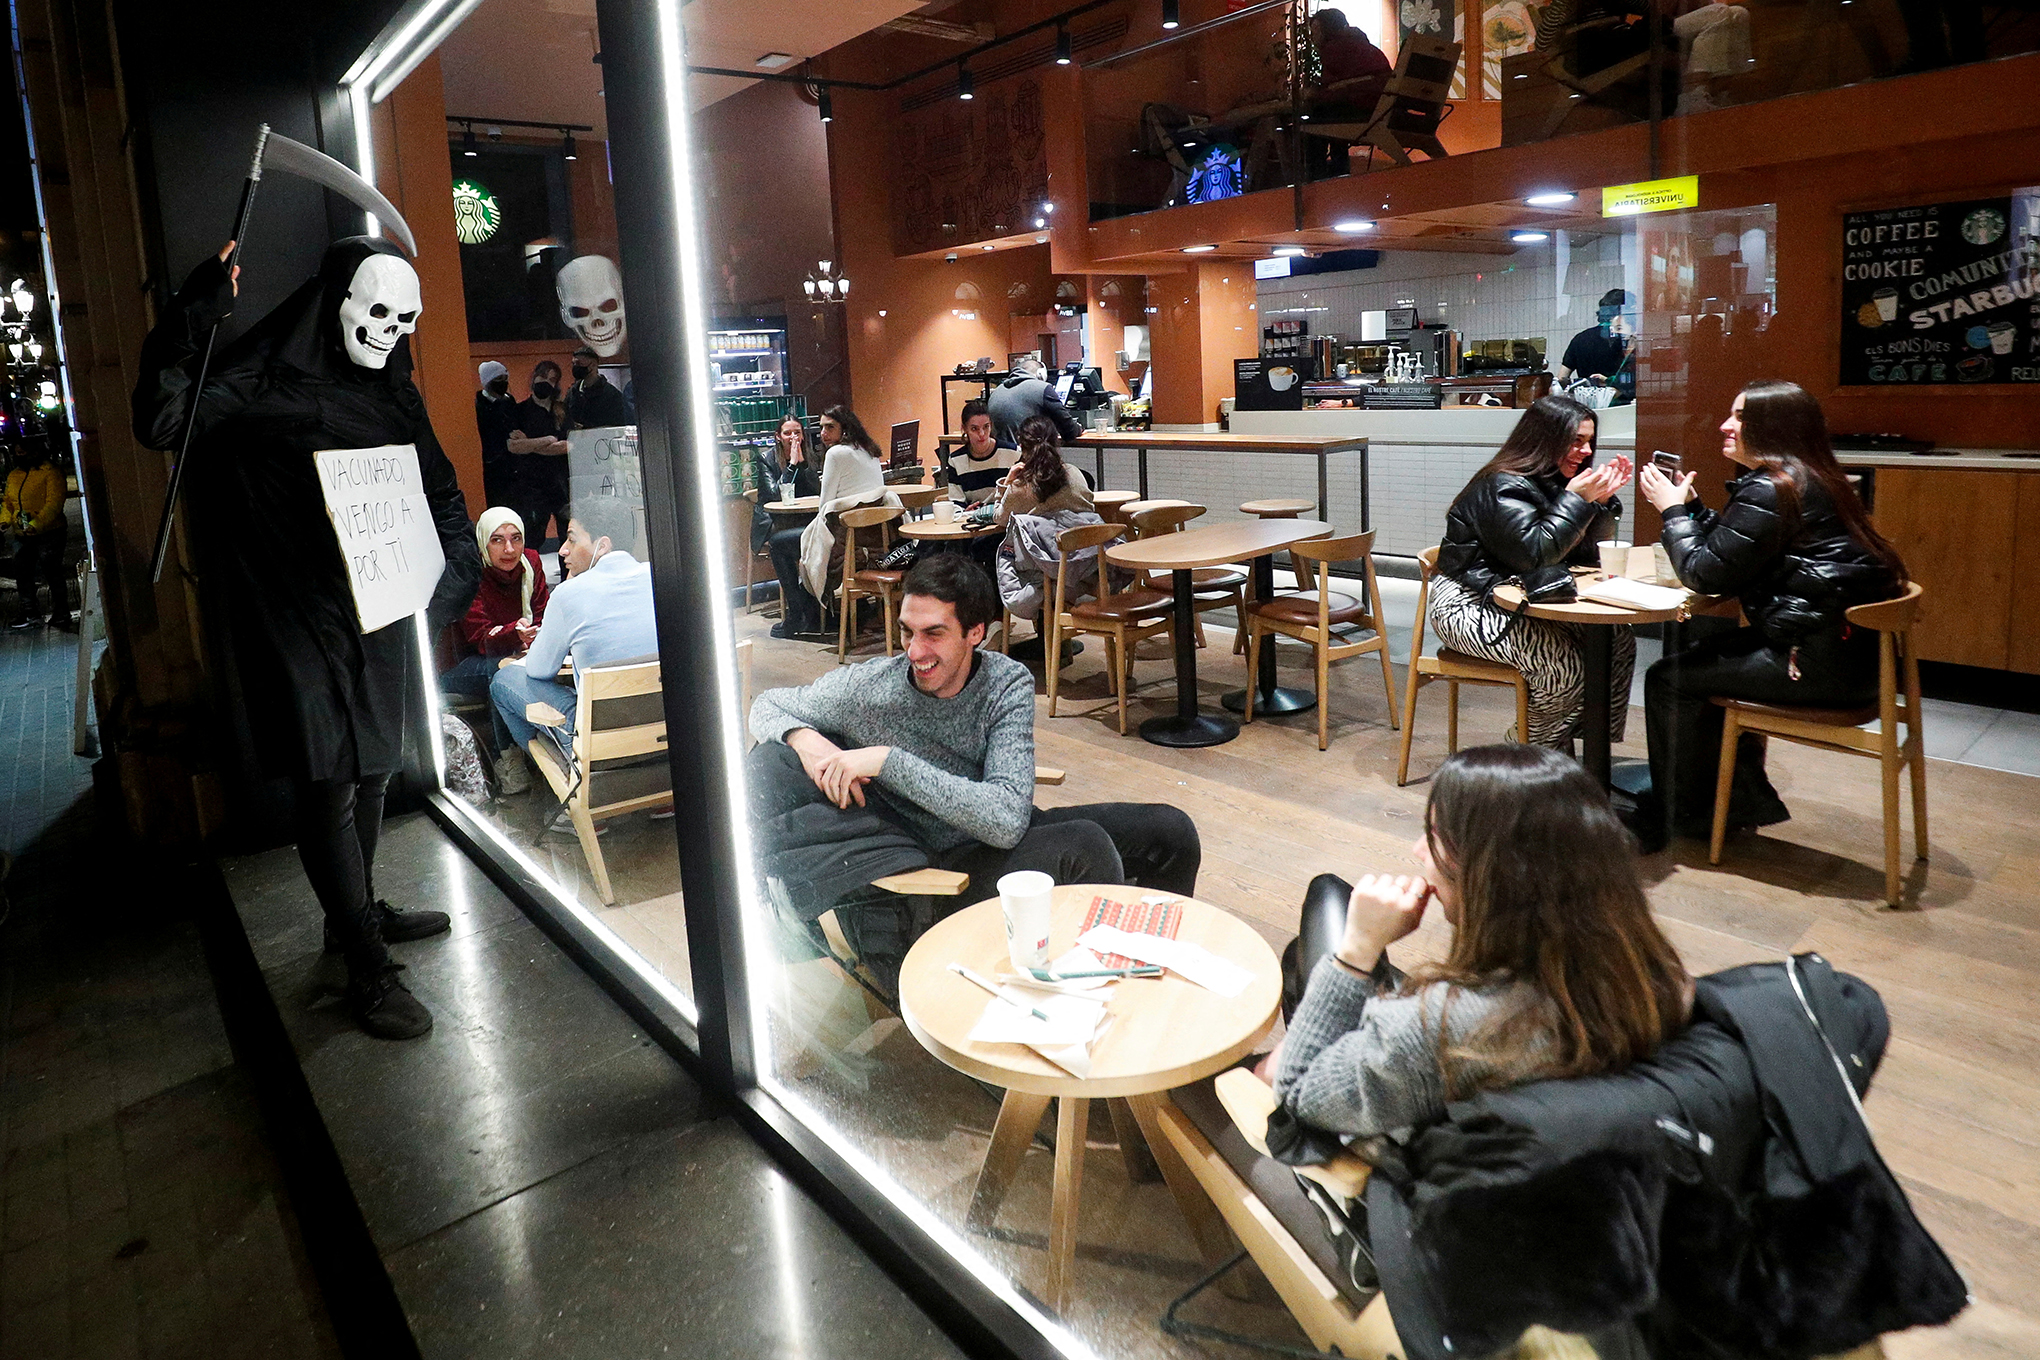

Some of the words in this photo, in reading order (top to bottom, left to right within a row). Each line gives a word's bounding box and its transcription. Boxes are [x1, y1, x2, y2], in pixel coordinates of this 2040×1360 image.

[1898, 209, 1923, 218] NEED
[1846, 220, 1940, 246] COFFEE
[1849, 250, 1873, 259] AND
[1882, 245, 1919, 255] MAYBE
[1844, 258, 1925, 280] COOKIE
[1888, 337, 1921, 354] BONS
[1924, 338, 1951, 353] DIES
[322, 457, 406, 491] VACUNADO,
[335, 500, 395, 540] VENGO
[402, 497, 415, 525] A
[353, 549, 388, 589] POR
